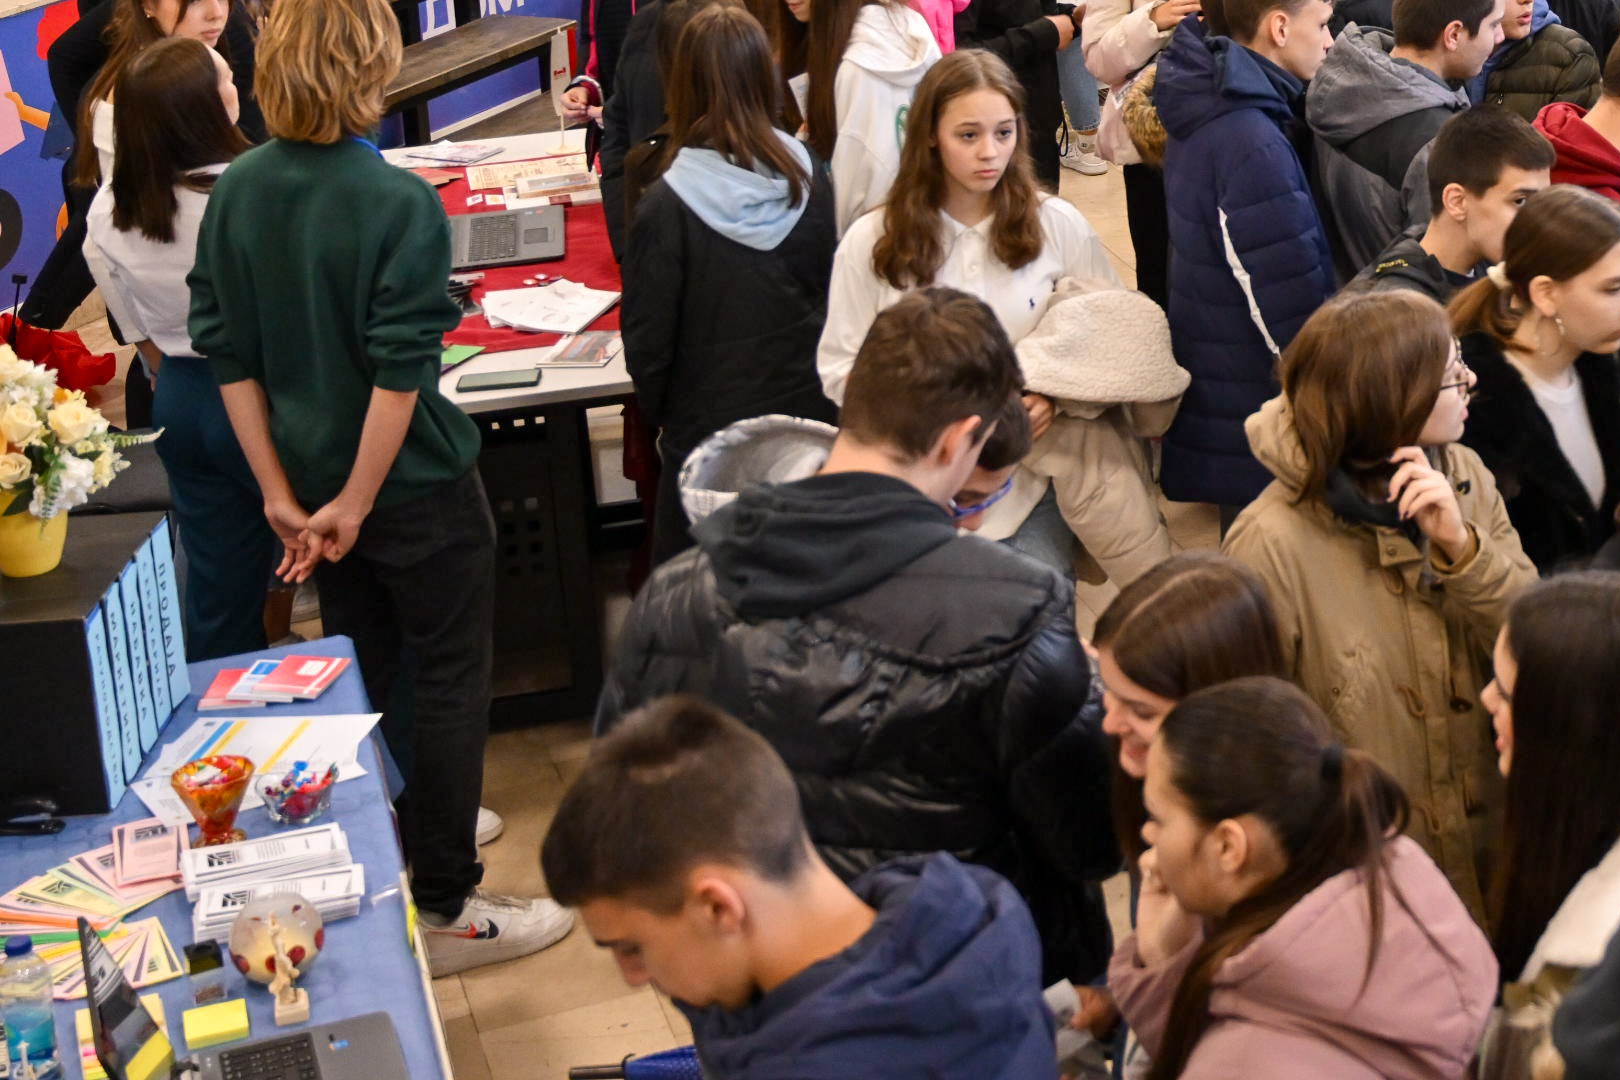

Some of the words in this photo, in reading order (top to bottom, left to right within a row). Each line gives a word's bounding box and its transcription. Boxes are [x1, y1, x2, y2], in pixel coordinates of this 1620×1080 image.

[130, 602, 148, 721] НАБАВКА
[159, 562, 176, 677] ПРОДАЈА
[110, 611, 133, 756] МАРКЕТИНГ
